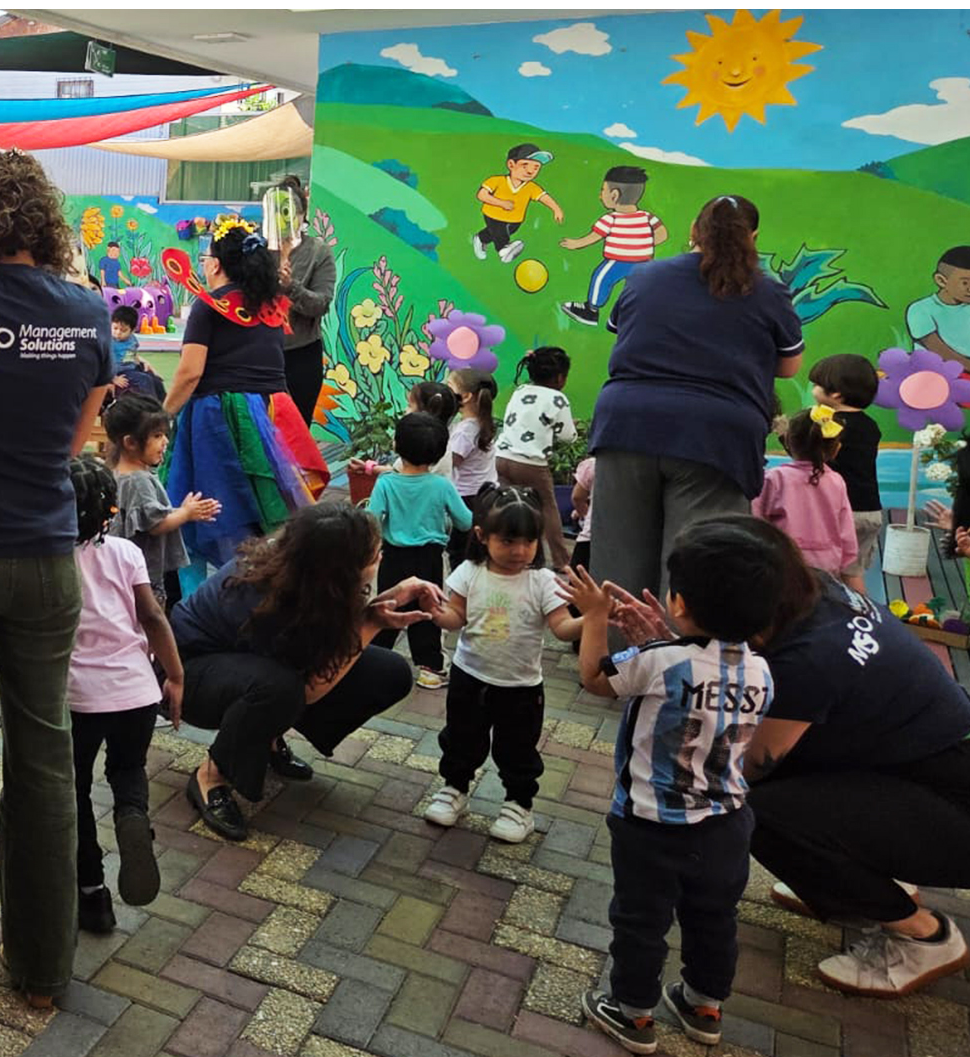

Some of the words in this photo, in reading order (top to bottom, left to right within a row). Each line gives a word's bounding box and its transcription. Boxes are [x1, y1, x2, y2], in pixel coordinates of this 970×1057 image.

[19, 324, 97, 342] Management
[19, 338, 75, 351] Solutions
[680, 678, 769, 715] MESSI
